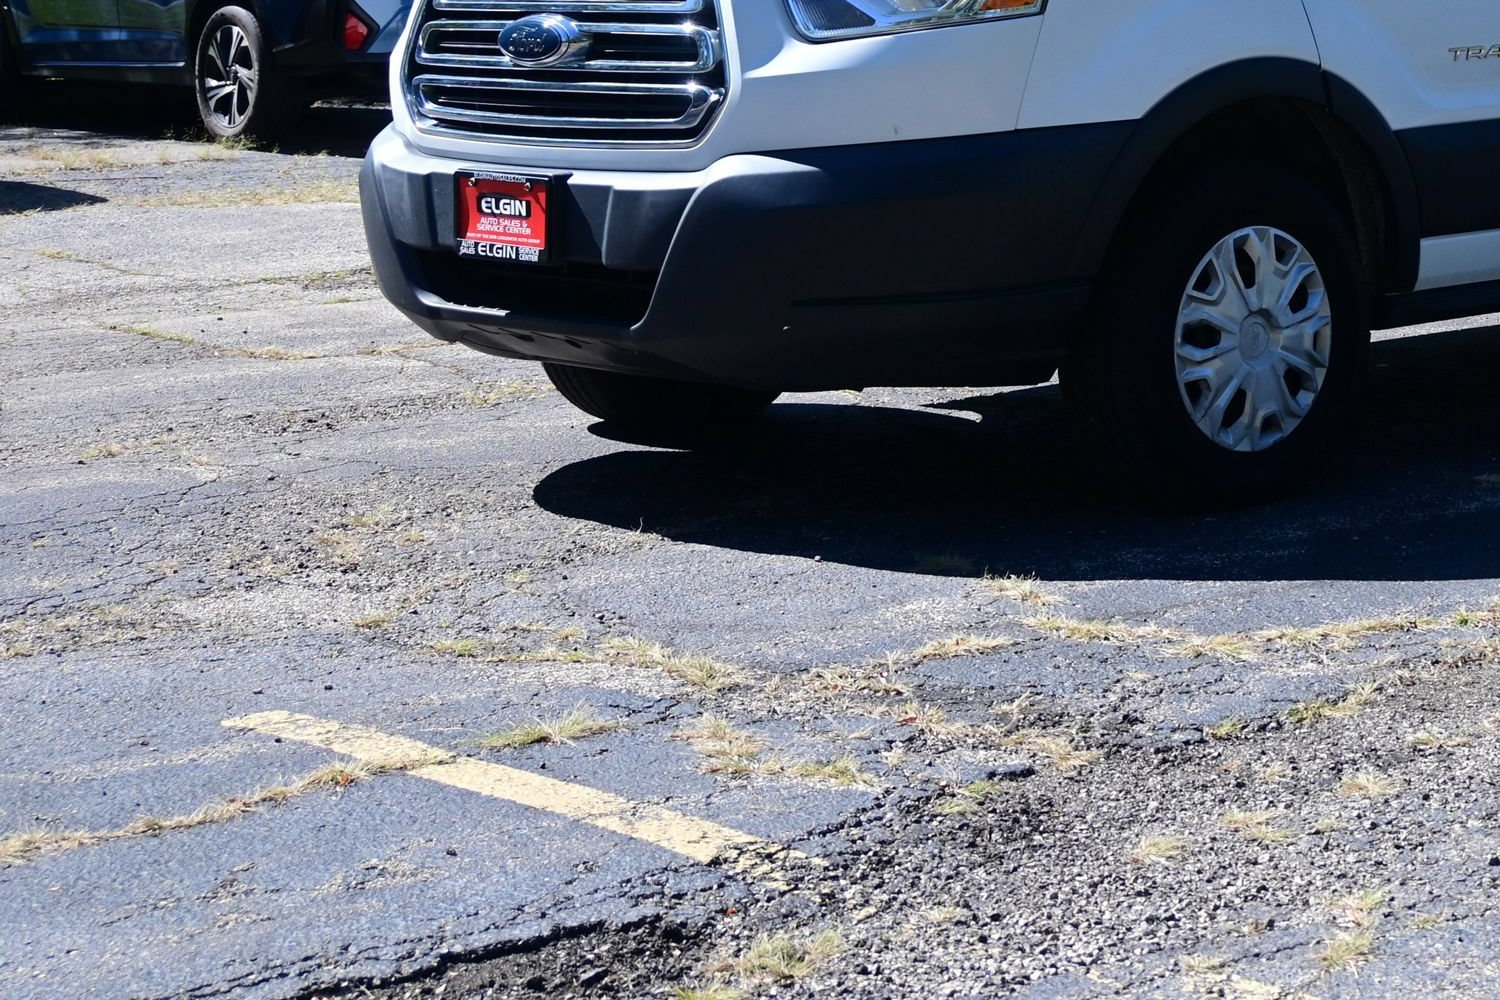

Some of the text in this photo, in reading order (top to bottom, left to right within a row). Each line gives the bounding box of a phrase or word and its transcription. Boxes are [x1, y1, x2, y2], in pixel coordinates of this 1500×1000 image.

[508, 25, 548, 53] Ford
[481, 197, 527, 217] ELGIN
[480, 217, 498, 225] AUTO
[499, 219, 521, 227] SALES
[476, 223, 531, 235] SERVICE CENTER
[459, 246, 476, 255] SALES
[477, 242, 516, 259] ELGIN
[518, 247, 540, 255] SERVICE
[518, 253, 539, 262] CENTER
